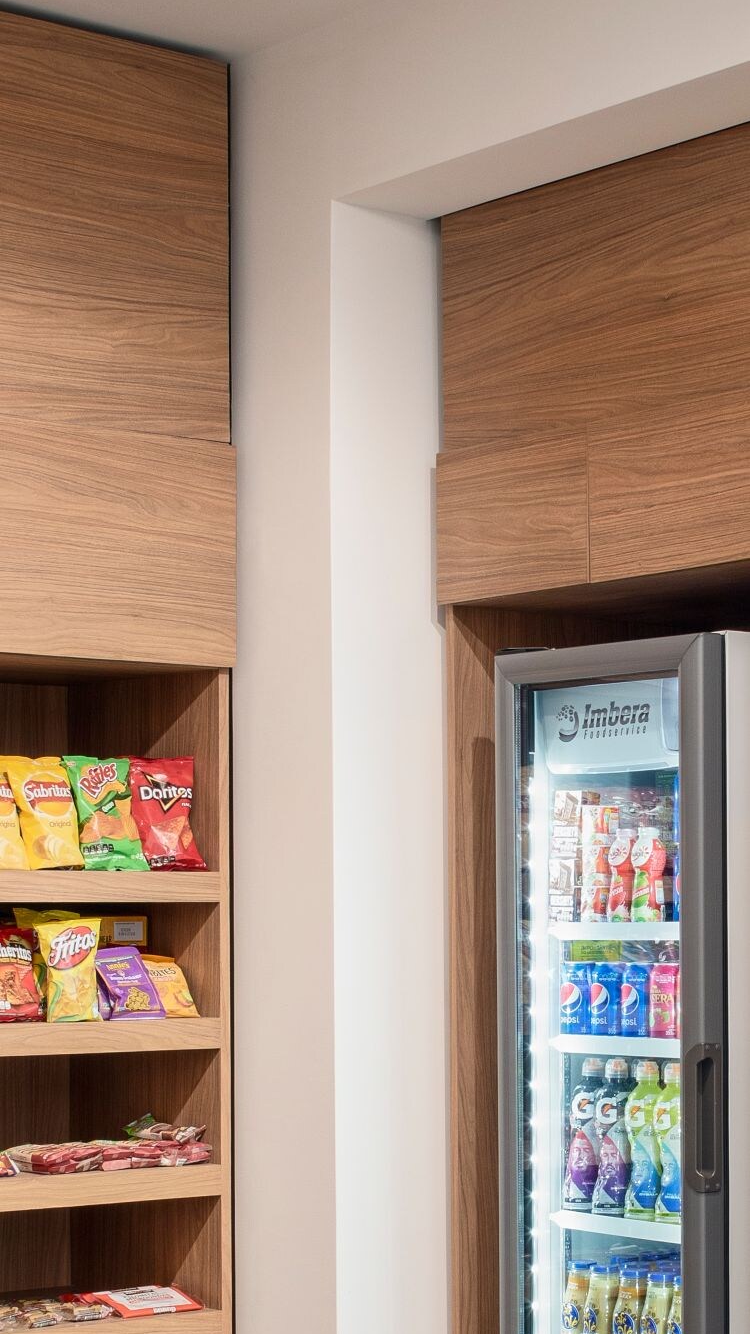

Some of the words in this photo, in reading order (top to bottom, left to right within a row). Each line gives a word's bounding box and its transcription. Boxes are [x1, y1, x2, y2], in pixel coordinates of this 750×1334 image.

[582, 701, 651, 729] Imbera
[583, 725, 647, 740] Foodservice
[24, 783, 72, 801] Sabritas
[79, 763, 118, 799] Ruffles
[141, 786, 192, 801] Doritos
[48, 926, 97, 967] Fritos
[572, 1092, 595, 1120] G
[596, 1097, 618, 1125] G
[625, 1100, 646, 1128] G
[653, 1102, 671, 1130] G
